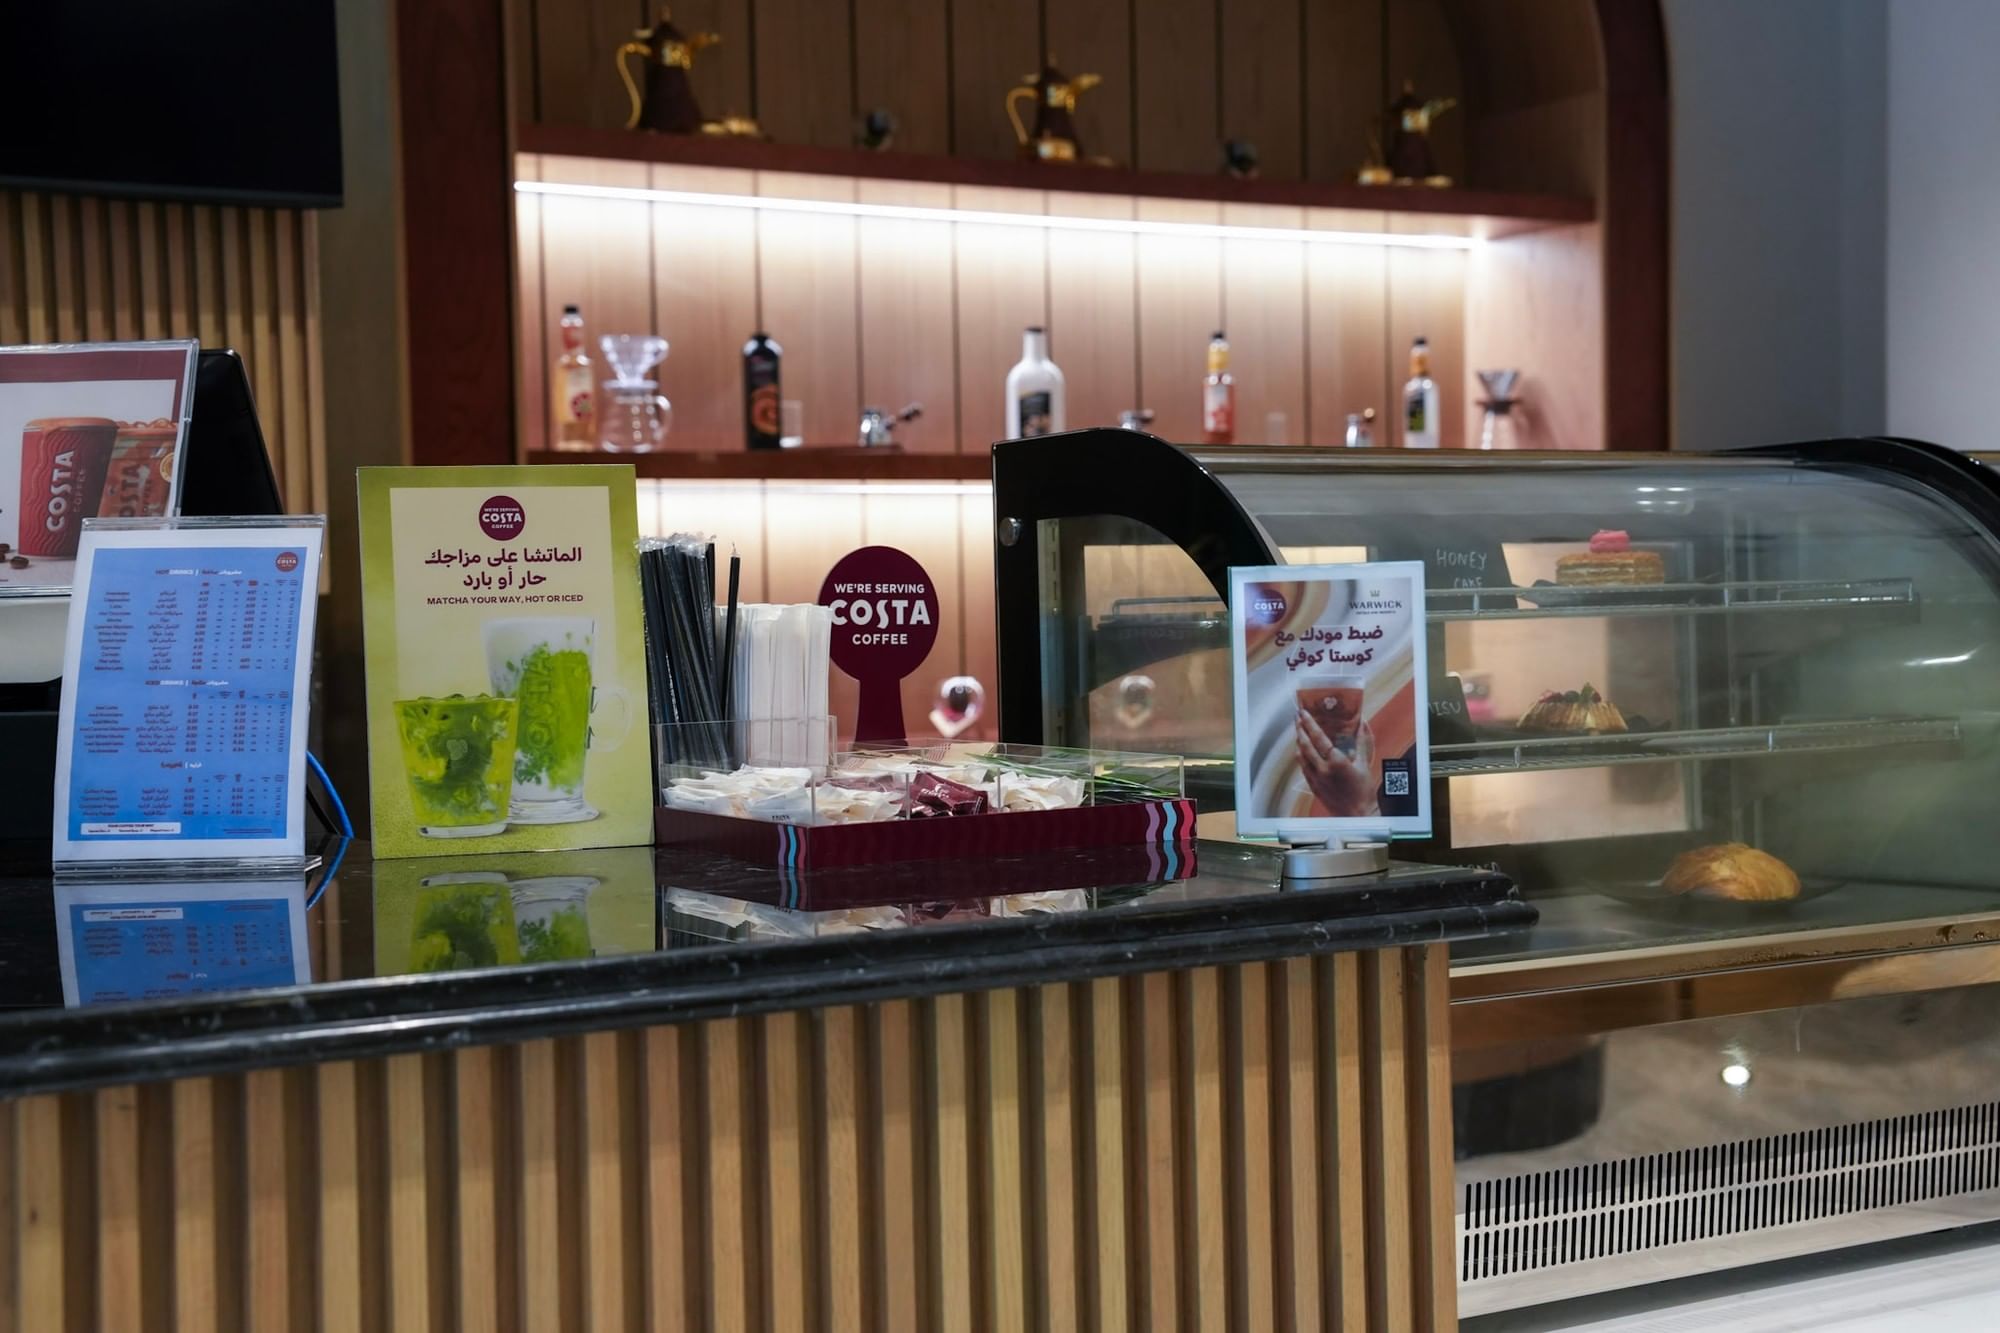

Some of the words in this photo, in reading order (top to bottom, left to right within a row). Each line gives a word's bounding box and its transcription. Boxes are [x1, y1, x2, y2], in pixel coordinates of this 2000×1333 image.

[46, 450, 75, 532] COSTA
[481, 512, 523, 524] COSTA
[424, 548, 482, 568] مزاجك
[487, 548, 518, 567] على
[523, 546, 582, 563] الماتشا
[1436, 548, 1488, 571] HONEY
[463, 571, 492, 590] بارد
[498, 565, 513, 590] أو
[518, 570, 547, 589] حار
[1454, 576, 1483, 589] CAKE
[834, 583, 872, 593] WE'RE
[875, 583, 925, 594] SERVING
[427, 597, 469, 605] MATCHA
[470, 596, 497, 604] YOUR
[499, 596, 524, 605] WAY,
[525, 595, 546, 603] HOT
[561, 594, 584, 602] ICED
[1254, 602, 1285, 611] COSTA
[1350, 600, 1402, 609] WARWICK
[830, 599, 931, 629] COSTA
[852, 633, 908, 645] COFFEE
[1274, 630, 1295, 646] مع
[1300, 627, 1343, 644] مودك
[1347, 625, 1383, 643] ضبط
[1286, 647, 1325, 671] كوفي
[1329, 648, 1374, 665] كوستا
[1428, 700, 1461, 716] ISU
